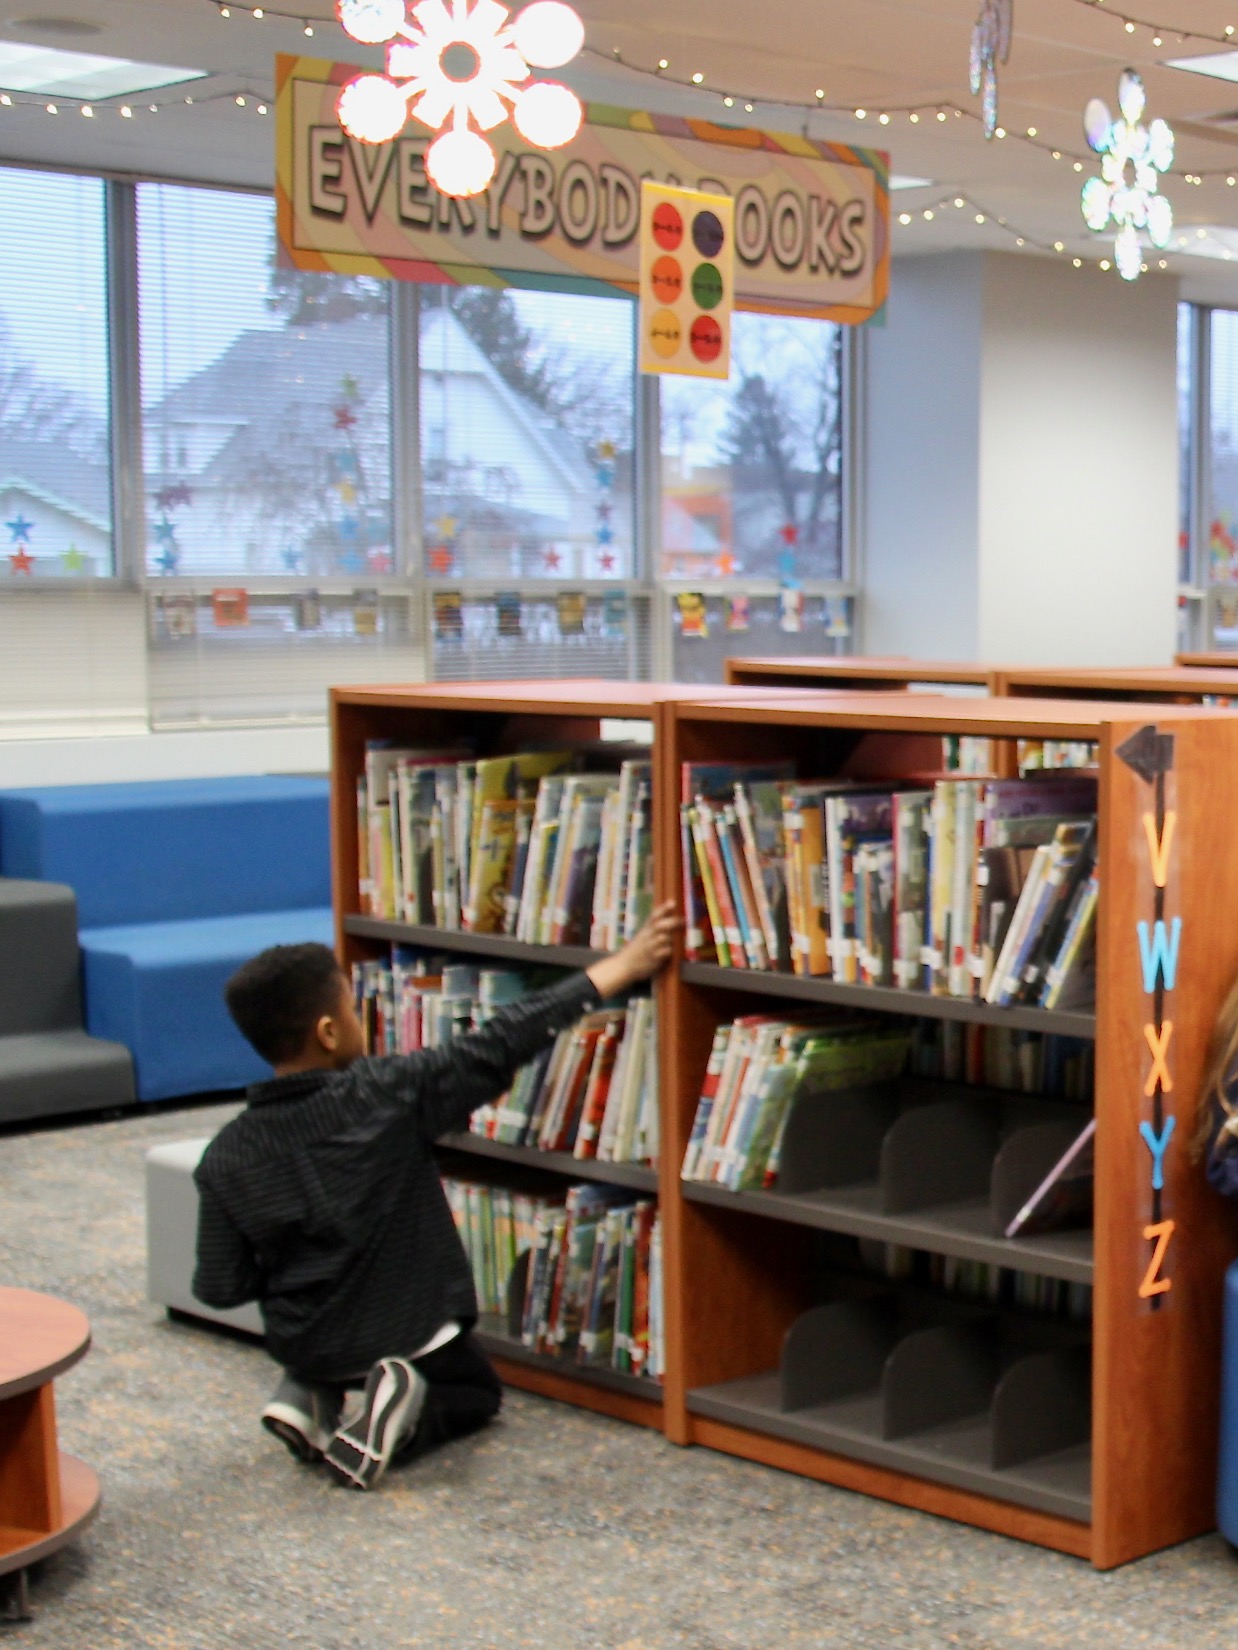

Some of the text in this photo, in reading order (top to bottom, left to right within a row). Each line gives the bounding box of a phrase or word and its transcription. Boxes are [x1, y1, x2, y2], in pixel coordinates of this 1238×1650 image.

[309, 125, 867, 279] EVEYBOD OOKS
[1137, 812, 1182, 1298] V W X Y Z
